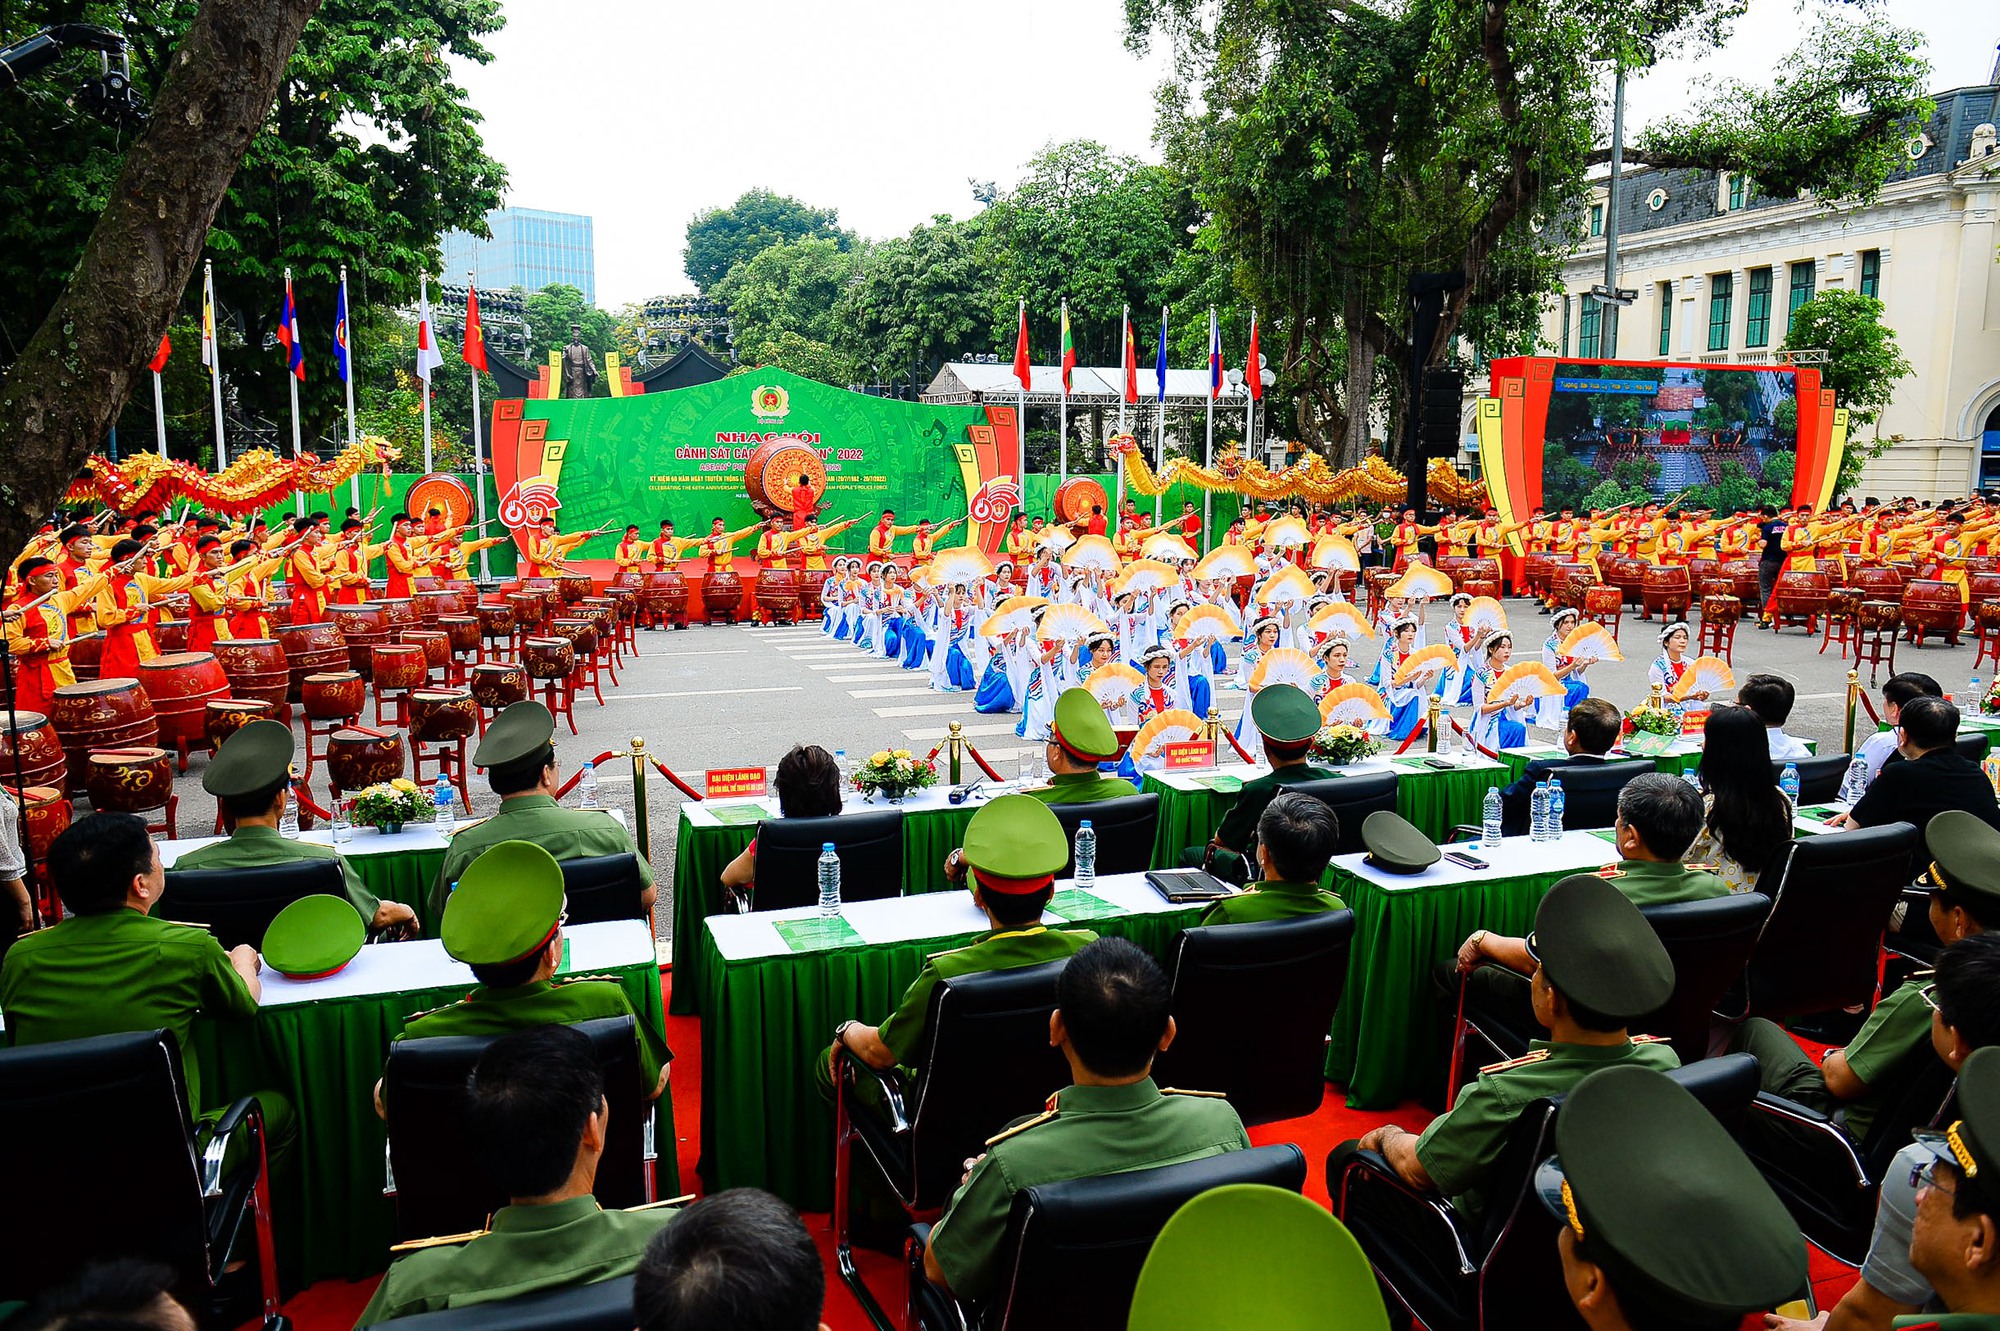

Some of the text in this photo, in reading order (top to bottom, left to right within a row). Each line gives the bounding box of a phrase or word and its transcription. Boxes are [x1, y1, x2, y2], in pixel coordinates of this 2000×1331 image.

[675, 443, 706, 460] CẢNH
[710, 445, 731, 460] SÁT
[837, 448, 864, 461] 2022
[712, 772, 761, 783] ĐẠI DIỆN LÃNH ĐẠO
